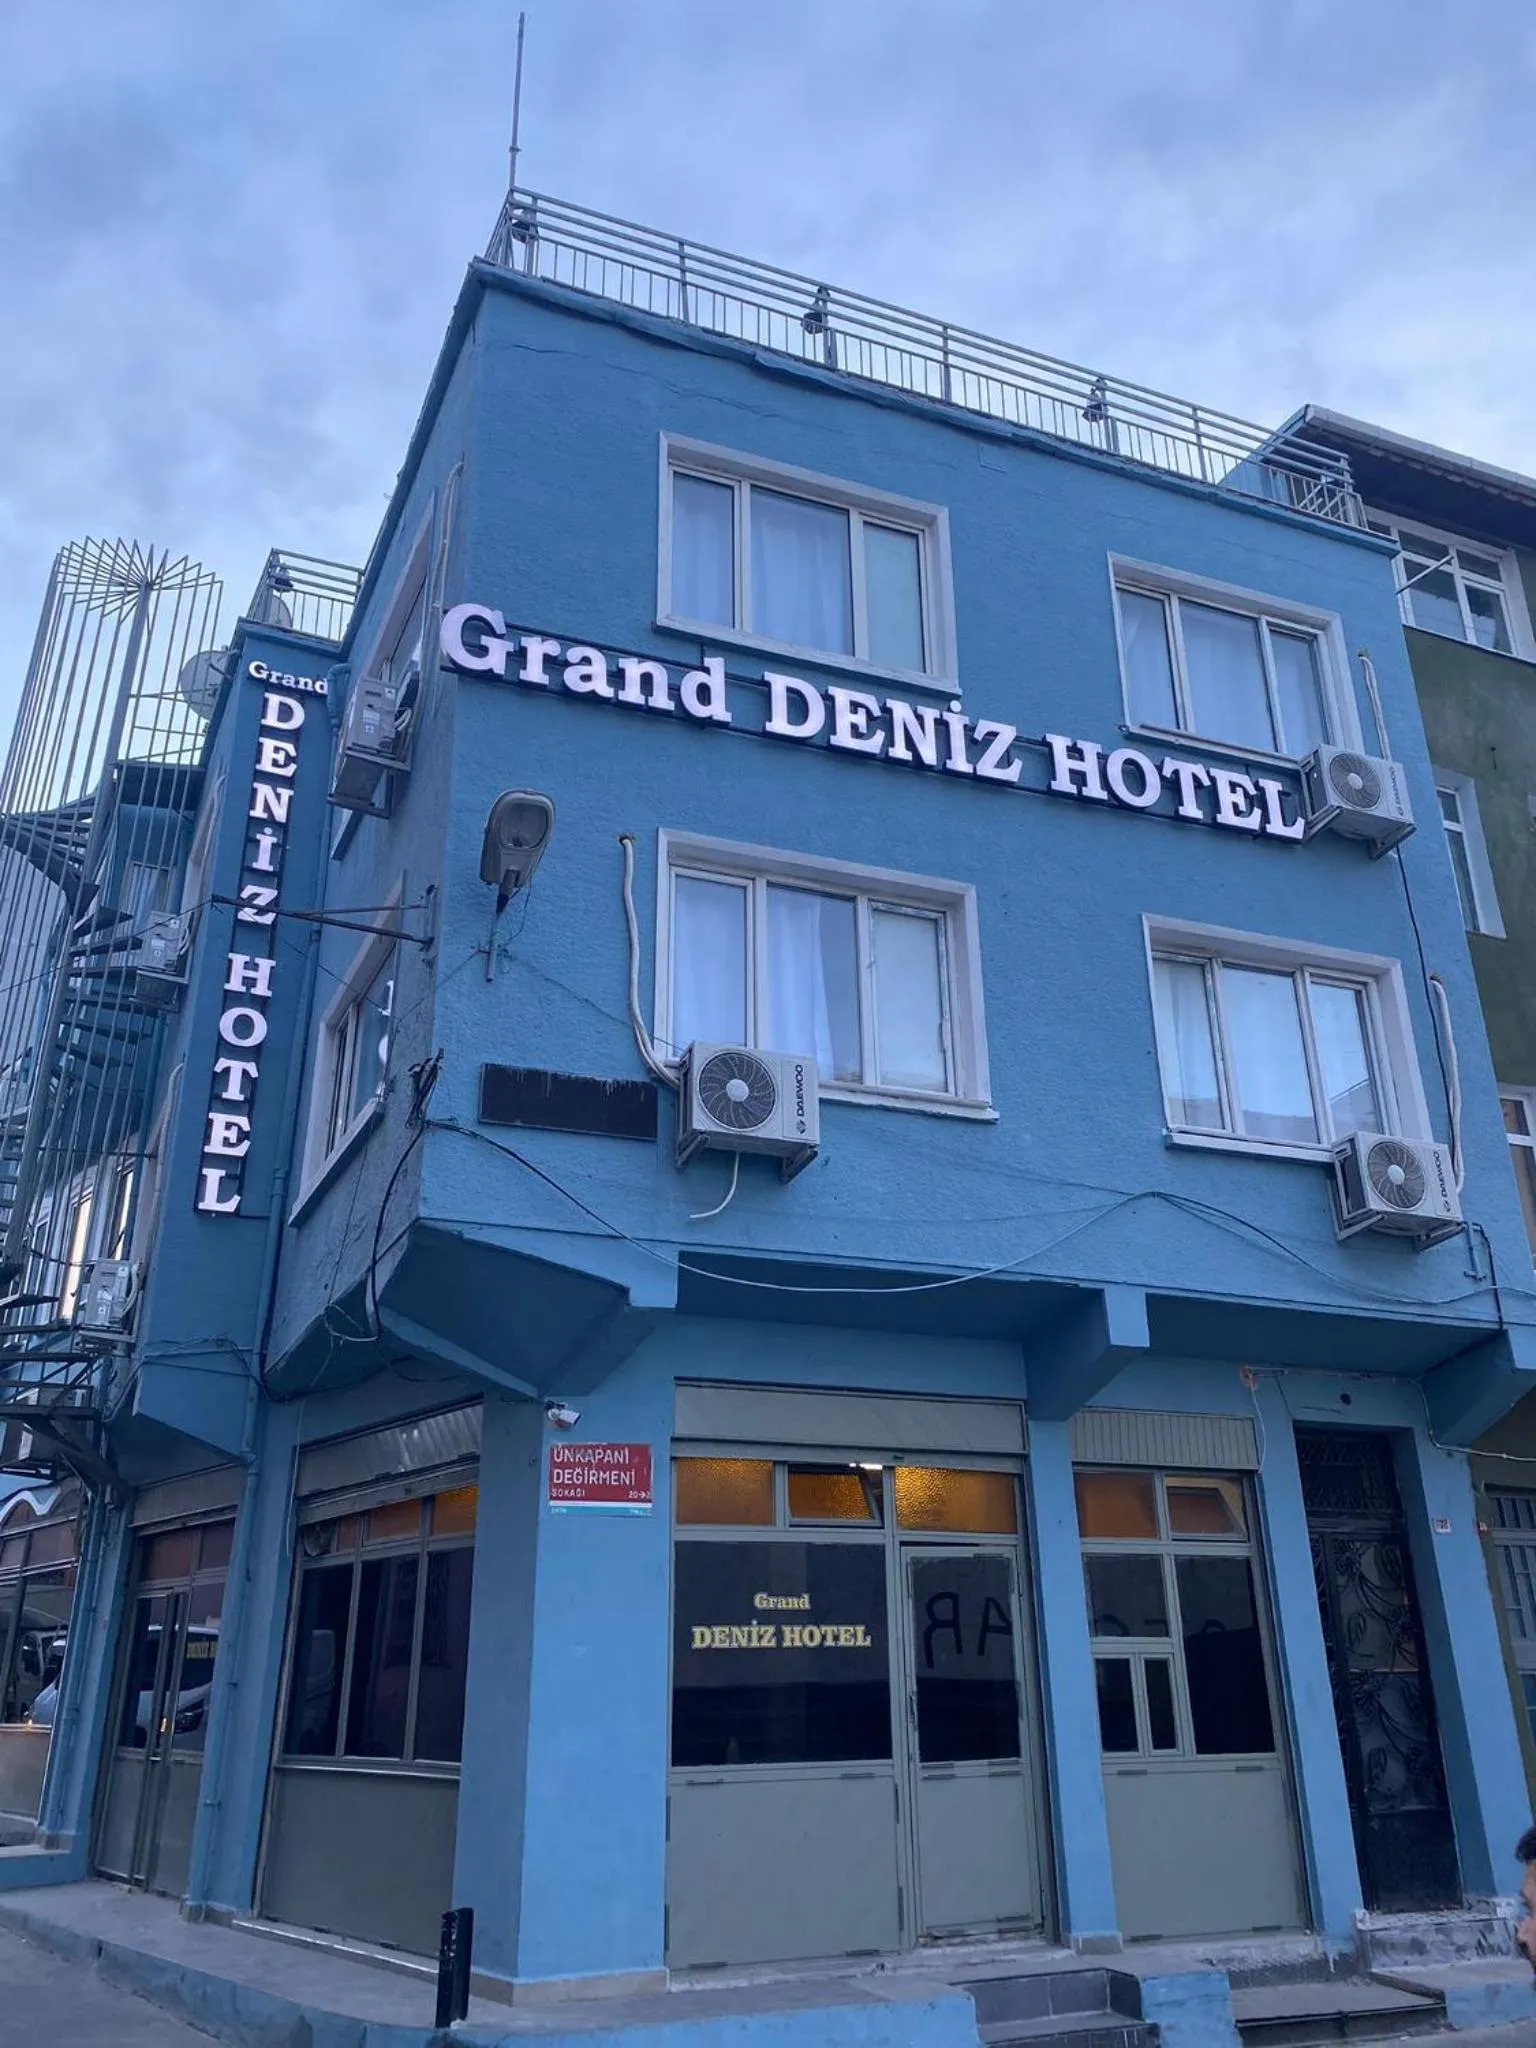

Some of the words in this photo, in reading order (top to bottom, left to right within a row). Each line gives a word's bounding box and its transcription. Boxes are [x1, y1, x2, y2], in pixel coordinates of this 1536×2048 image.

[249, 660, 328, 695] Grand
[440, 603, 732, 722] Grand
[763, 671, 1023, 783] DENİZ
[1044, 733, 1306, 839] HOTEL
[237, 691, 306, 925] DENİZ
[198, 952, 276, 1213] HOTEL
[795, 1064, 805, 1117] DAEWOO
[553, 1467, 636, 1486] DEĞİRMENİ
[754, 1592, 811, 1610] Grand
[692, 1619, 777, 1649] DENİZ
[781, 1625, 872, 1648] HOTEL
